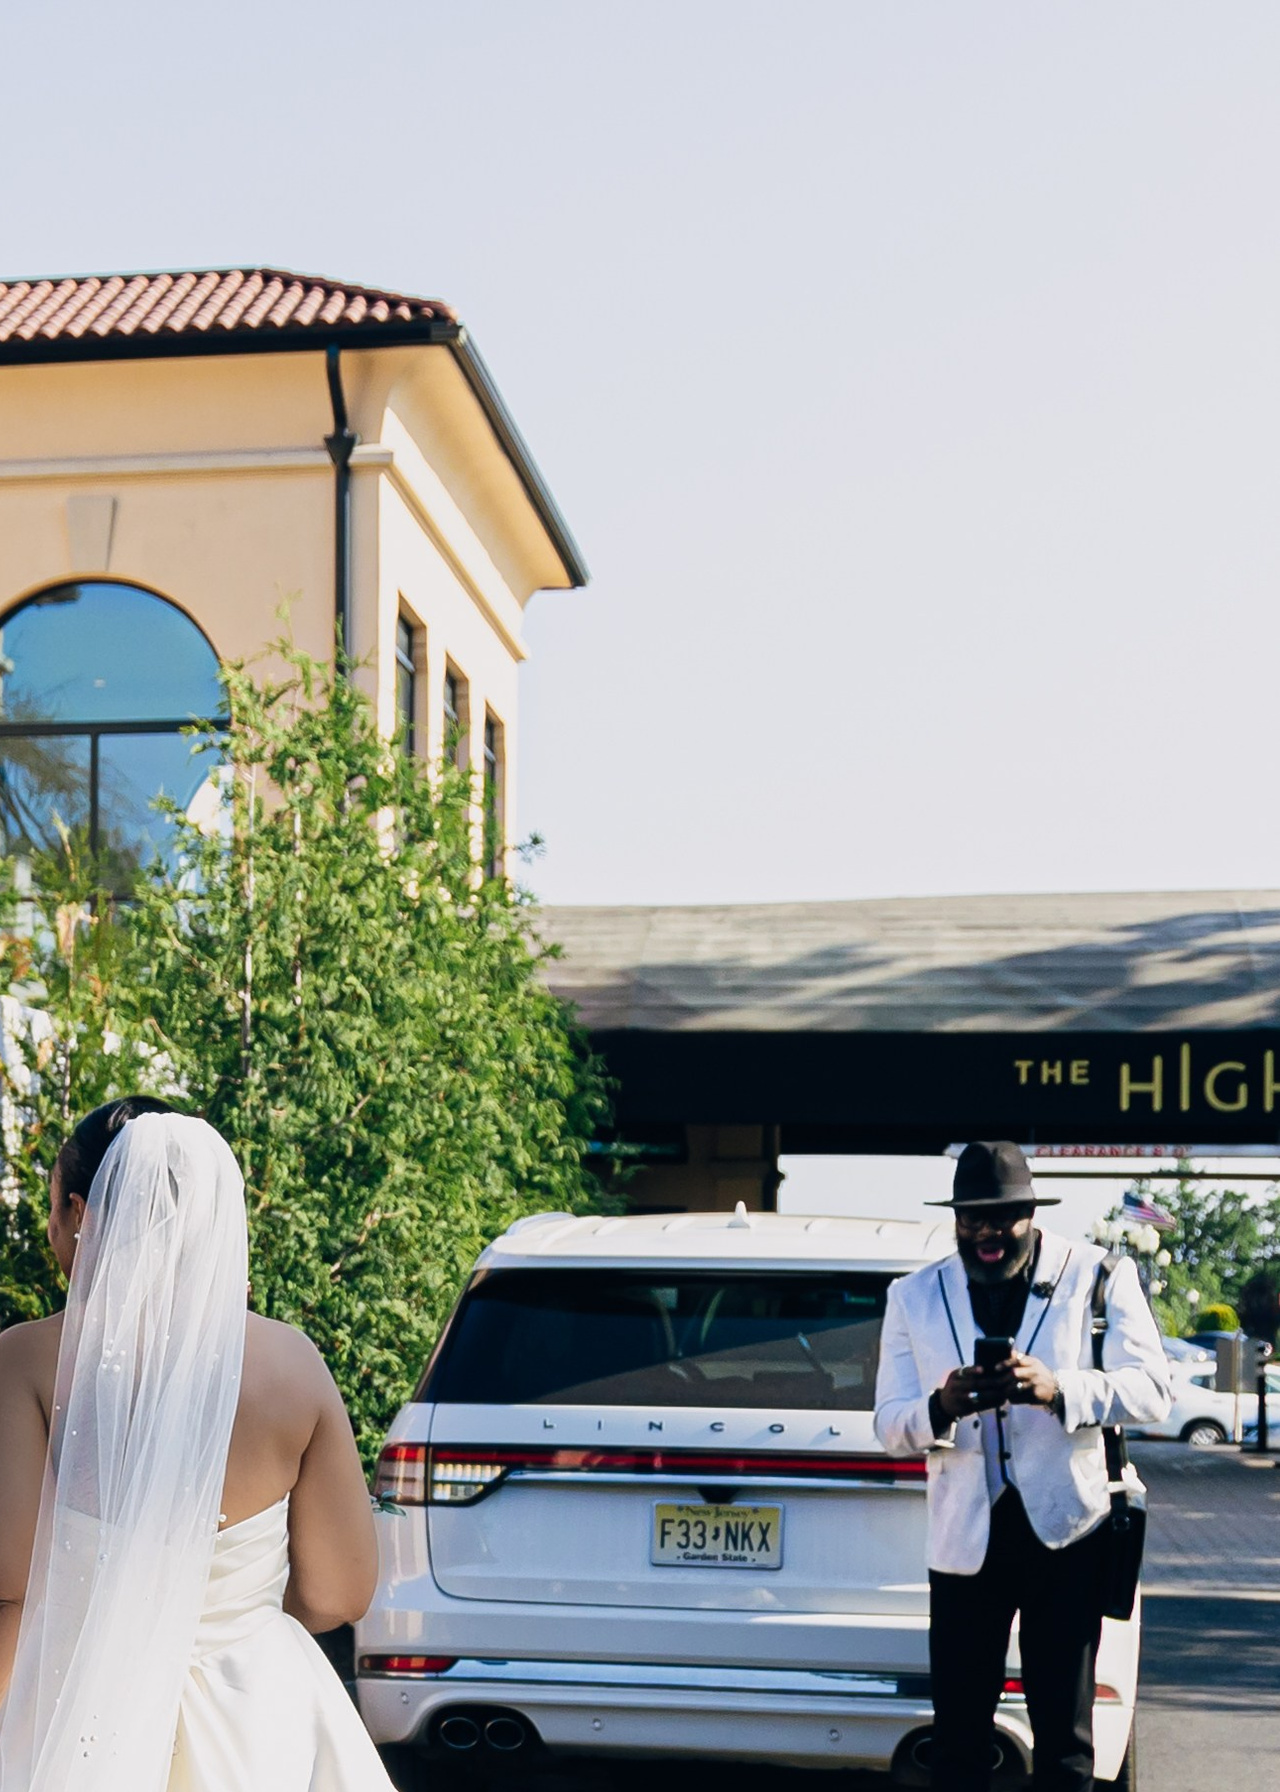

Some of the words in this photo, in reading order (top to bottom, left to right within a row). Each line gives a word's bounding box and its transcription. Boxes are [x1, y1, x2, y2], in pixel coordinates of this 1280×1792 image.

[1014, 1060, 1090, 1085] THE
[1035, 1145, 1144, 1157] CLEARANCE
[682, 1552, 718, 1562] Garden
[722, 1553, 747, 1562] State
